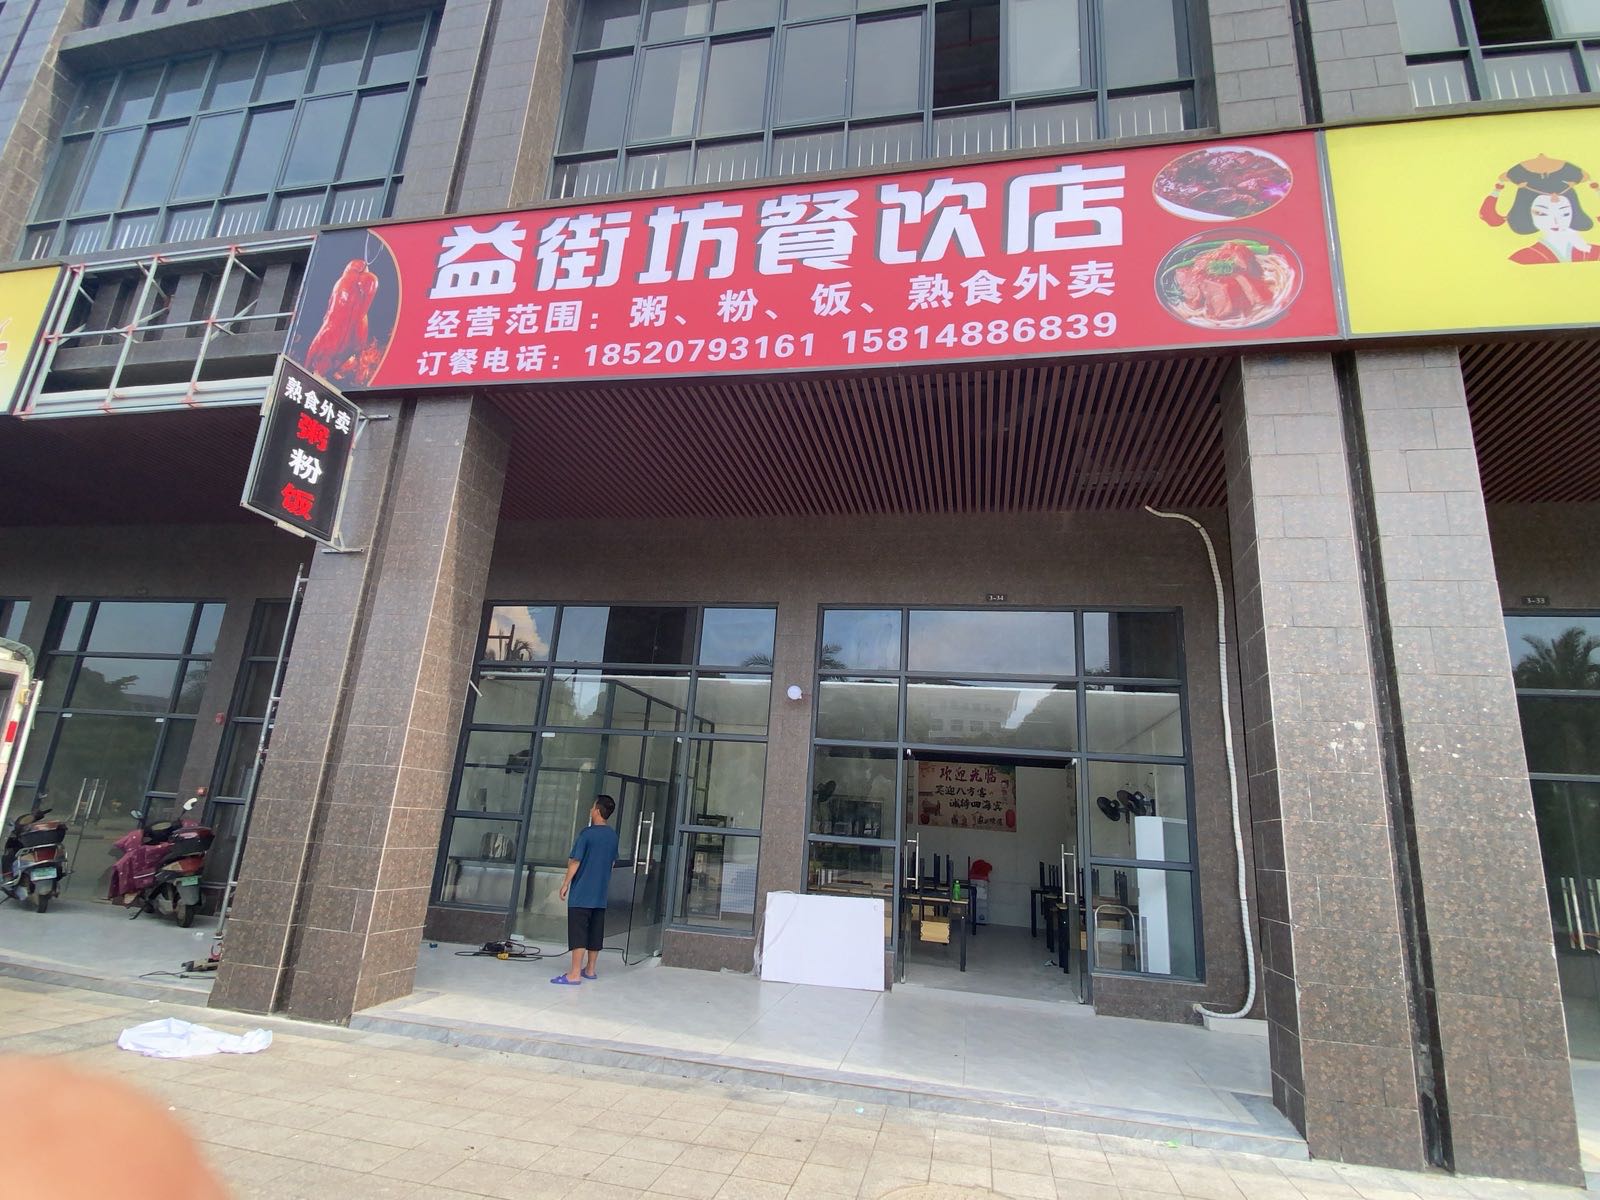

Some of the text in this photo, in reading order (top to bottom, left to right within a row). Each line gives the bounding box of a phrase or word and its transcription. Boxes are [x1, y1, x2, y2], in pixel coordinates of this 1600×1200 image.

[429, 164, 1126, 300] 益街坊餐饮店
[584, 332, 815, 367] 18520793161
[842, 311, 1118, 355] 15814886839
[284, 376, 352, 435] 熟食外卖
[940, 765, 997, 784] 欢迎光临
